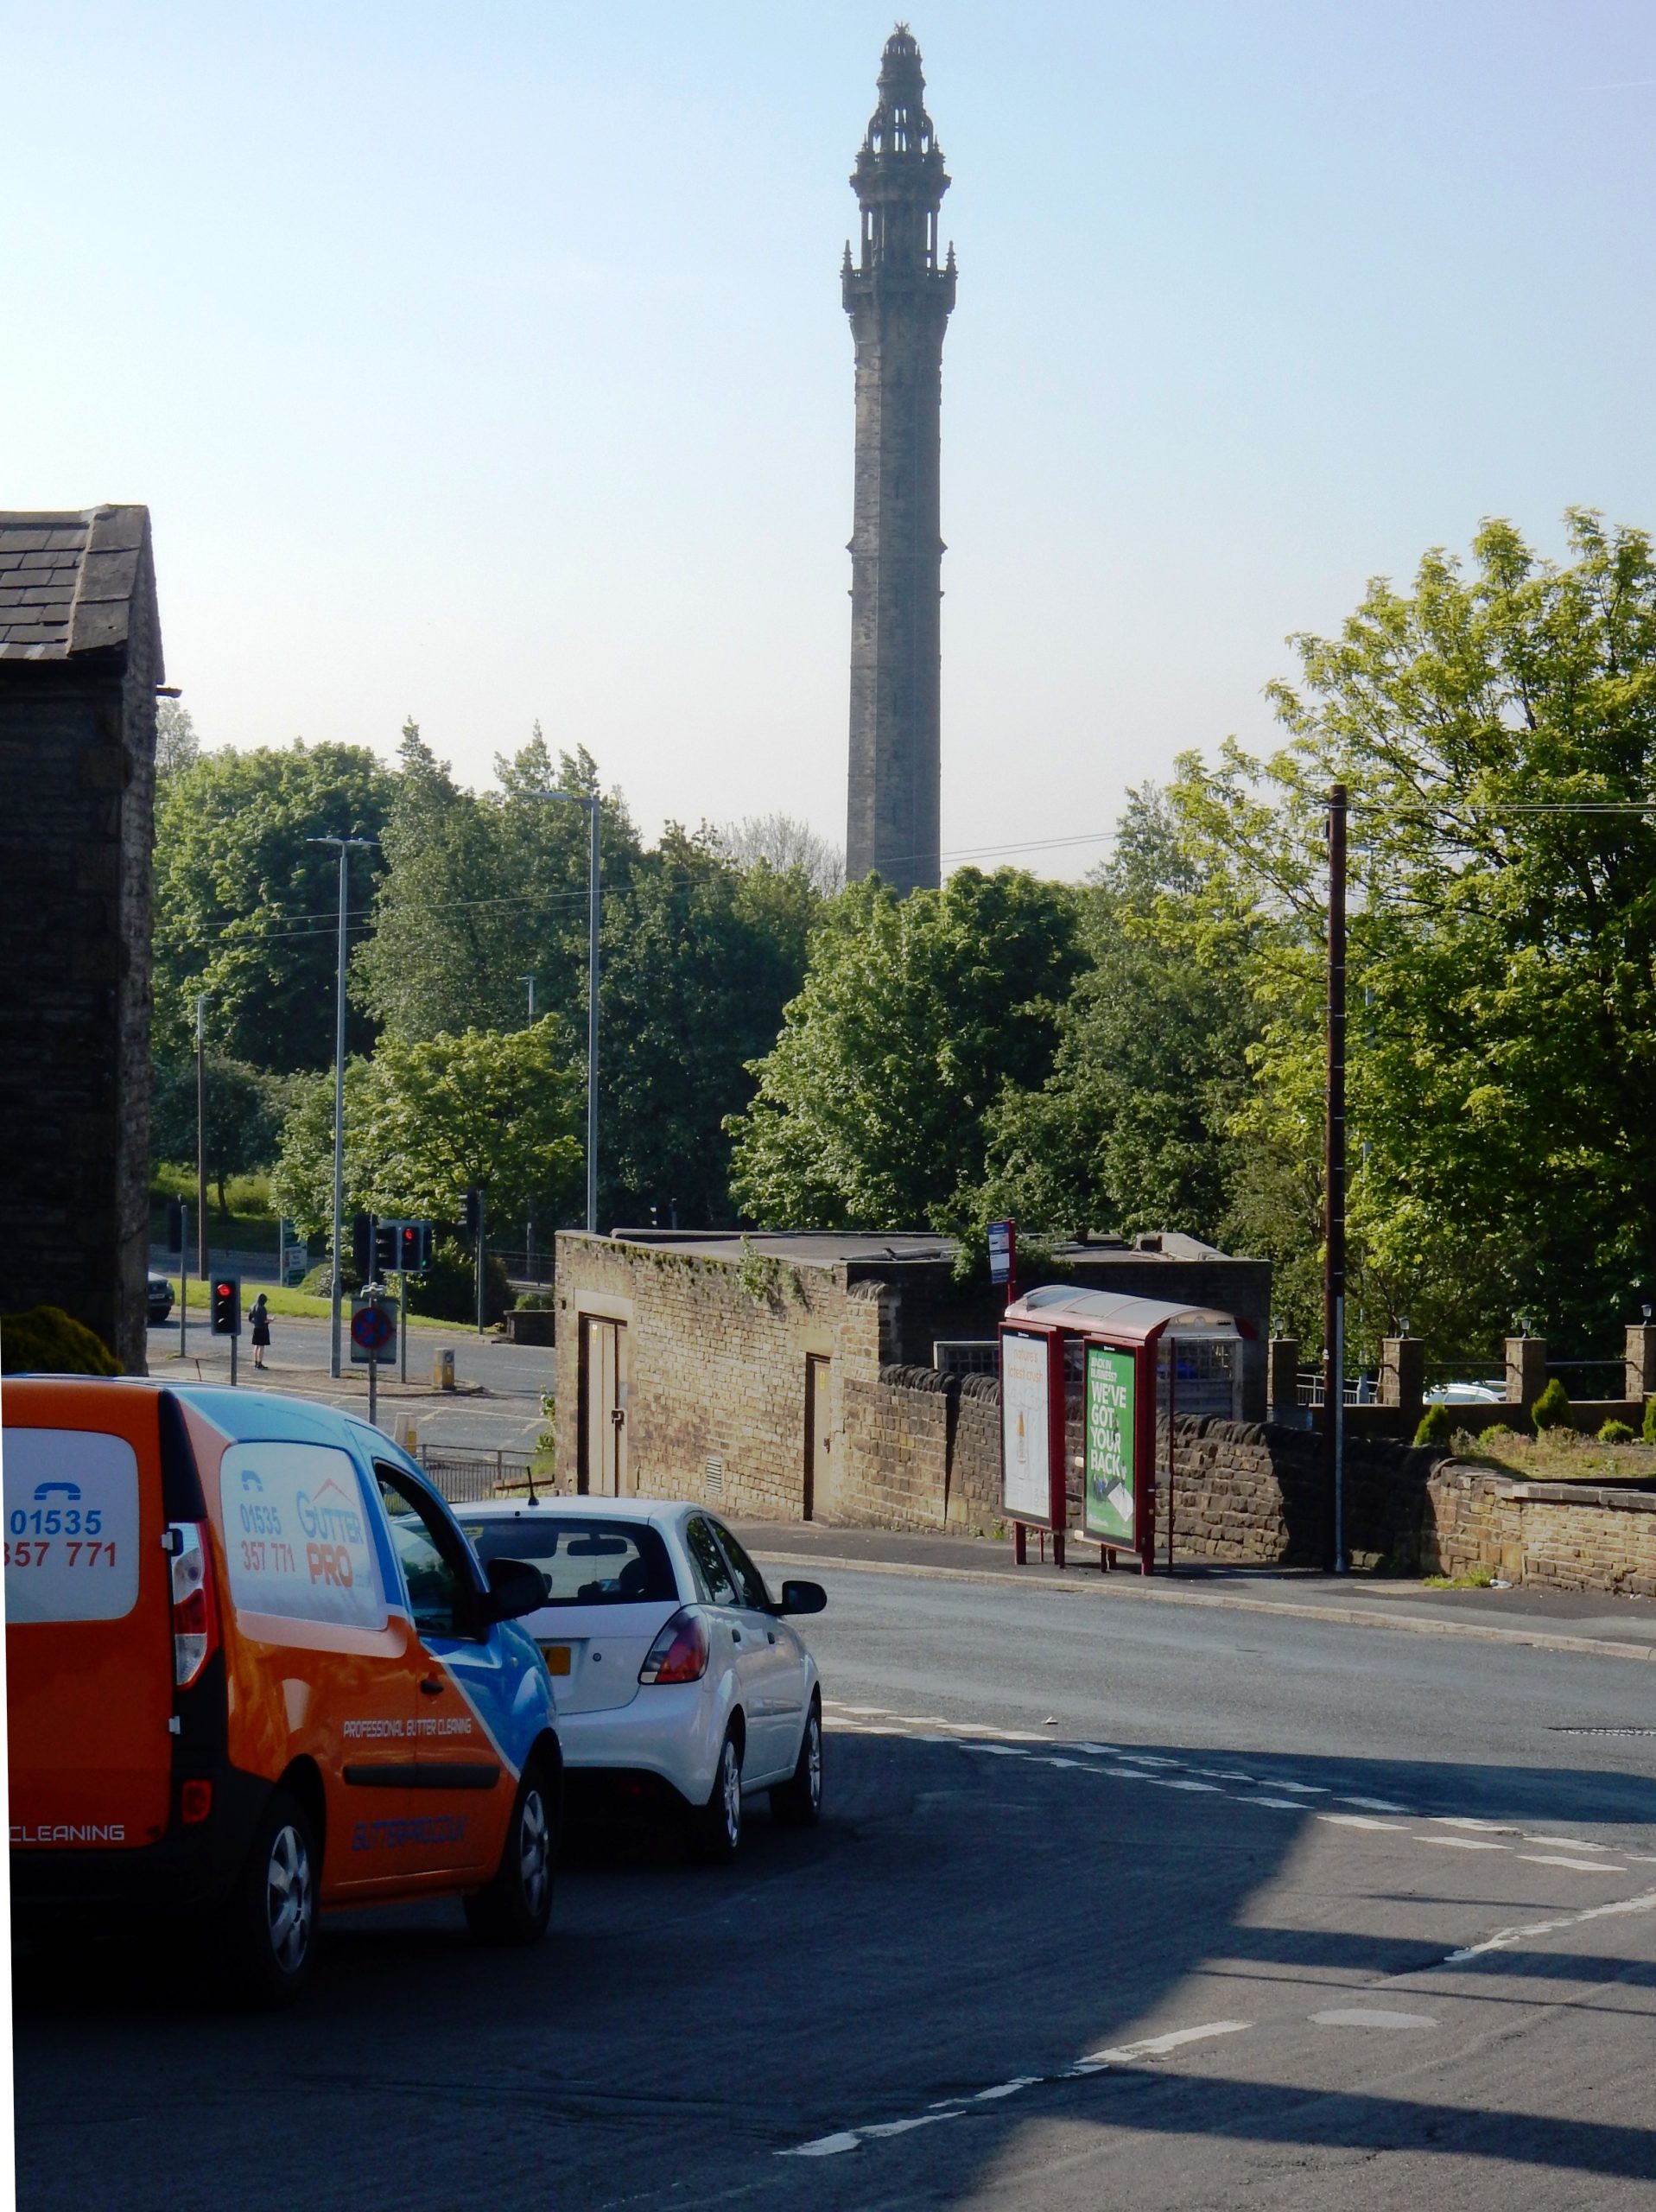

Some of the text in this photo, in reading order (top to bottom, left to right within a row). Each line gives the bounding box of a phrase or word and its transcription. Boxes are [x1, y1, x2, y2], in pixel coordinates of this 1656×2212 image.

[1091, 1381, 1126, 1408] WE'VE
[1091, 1404, 1115, 1428] GOT
[1090, 1426, 1121, 1453] YOUR
[1090, 1448, 1120, 1477] BACK
[10, 1510, 102, 1535] 01535
[240, 1503, 282, 1535] 01535
[296, 1491, 364, 1545] GUTTER
[67, 1542, 116, 1567] 771
[241, 1541, 295, 1573] 357 771
[306, 1542, 353, 1588] PRO
[343, 1718, 472, 1738] PROFESSIONAL GUTTER CLEANING
[10, 1825, 125, 1841] CLEANING
